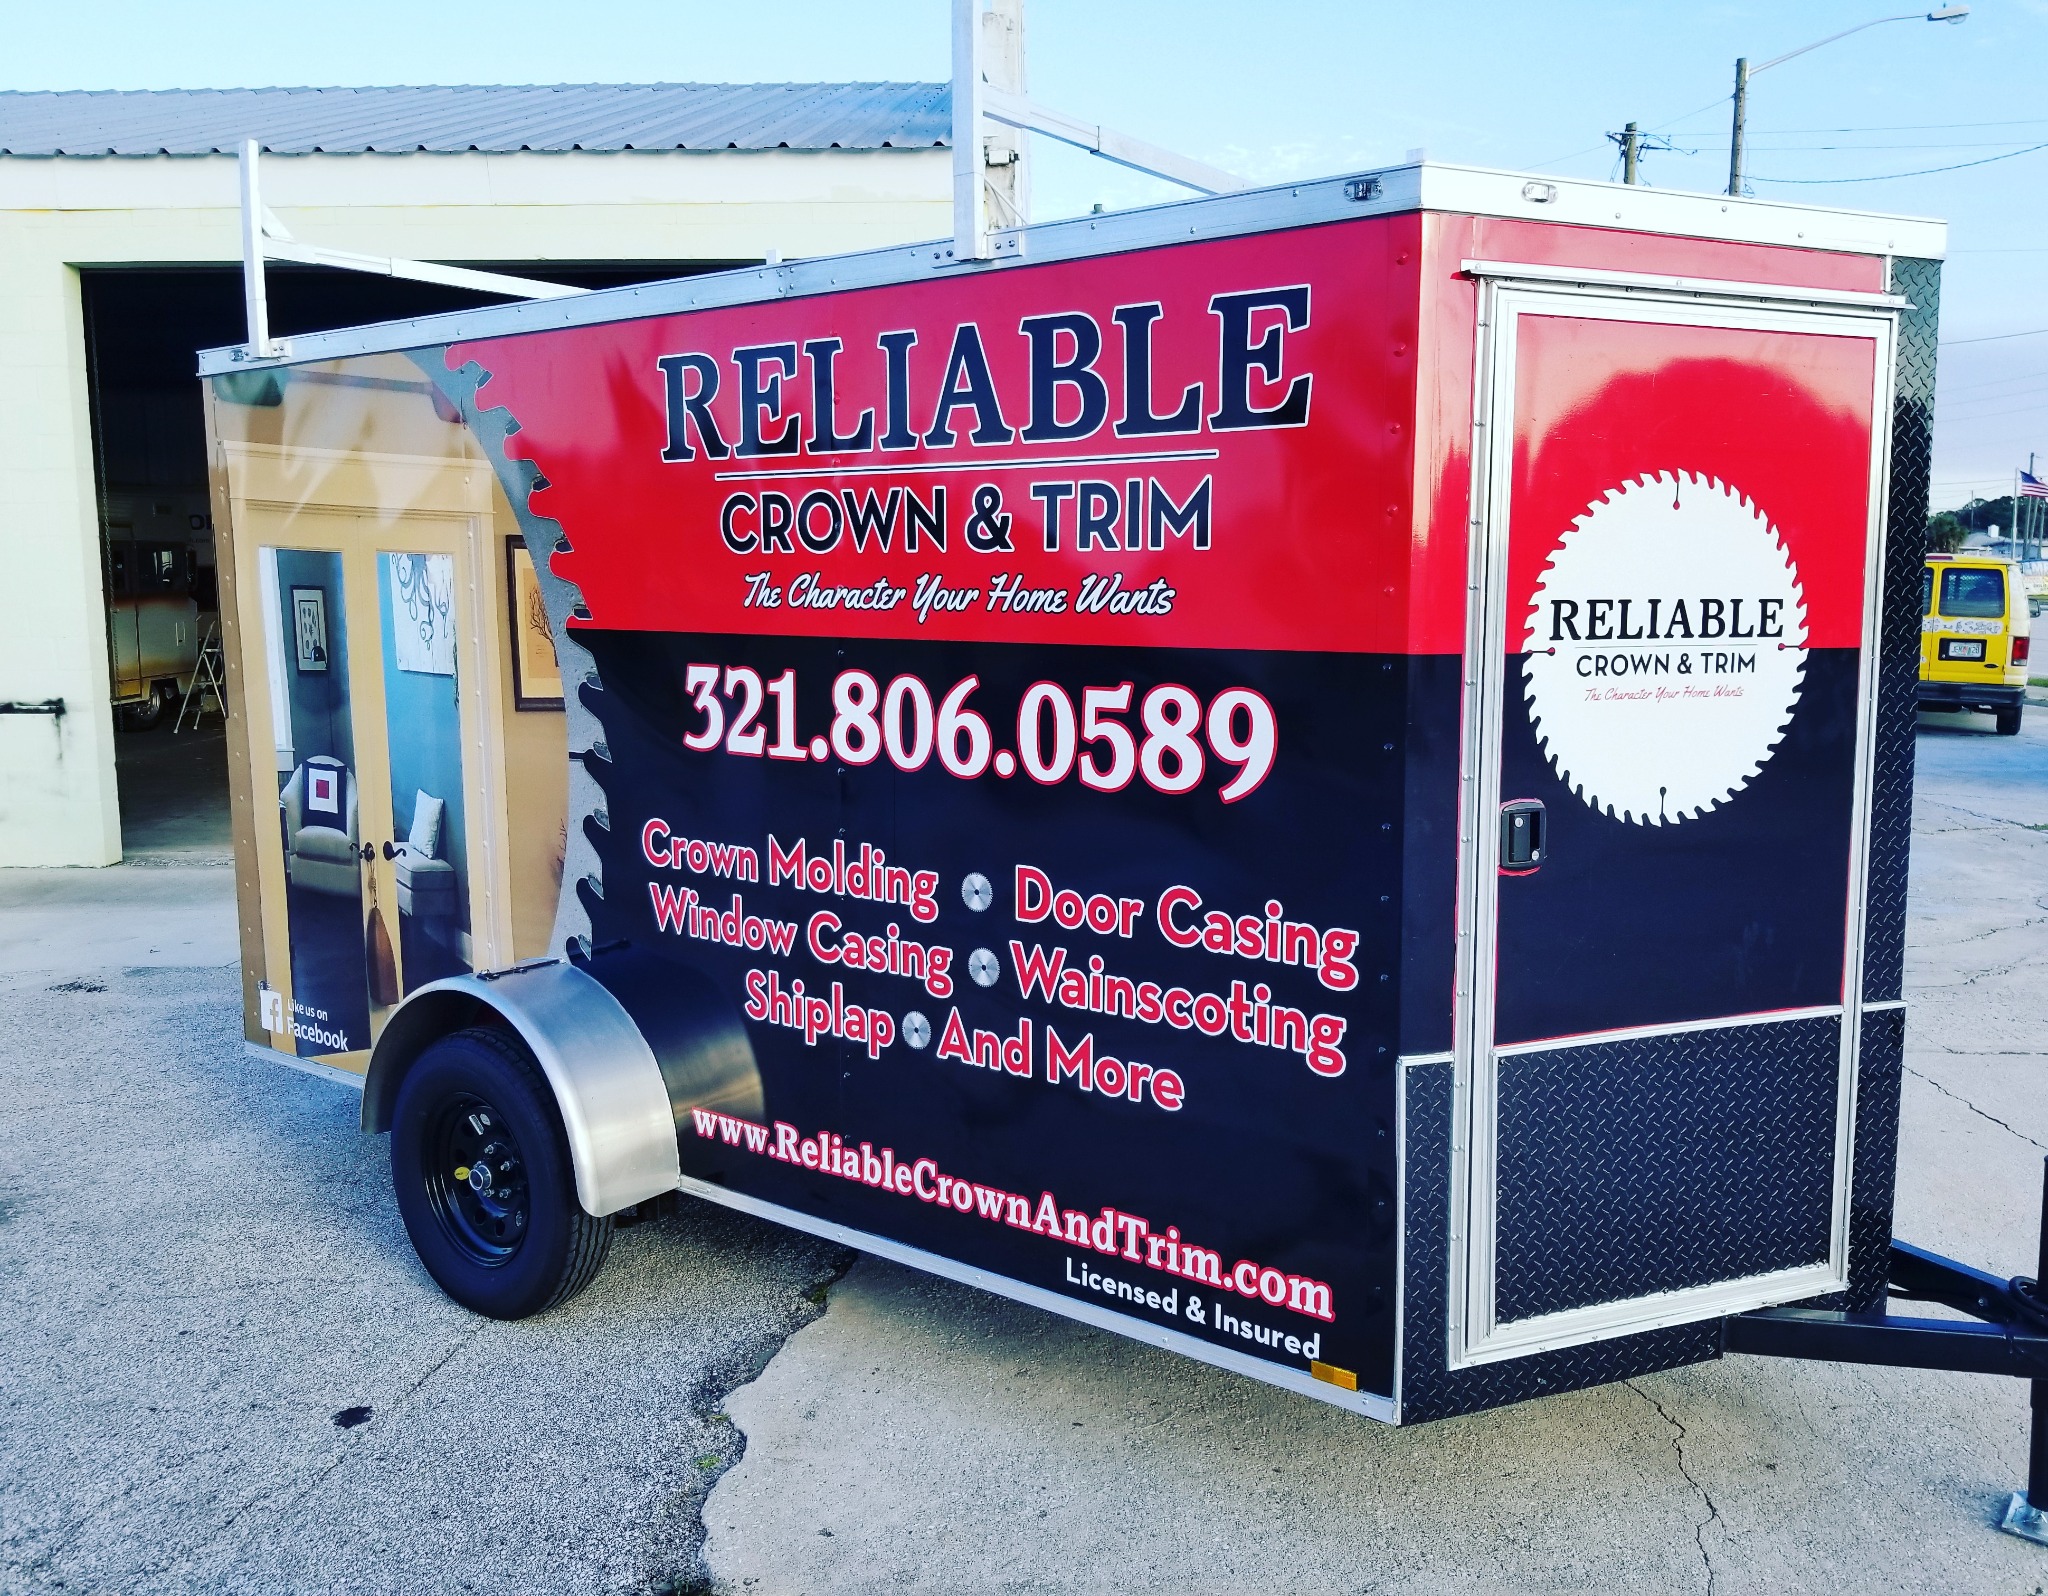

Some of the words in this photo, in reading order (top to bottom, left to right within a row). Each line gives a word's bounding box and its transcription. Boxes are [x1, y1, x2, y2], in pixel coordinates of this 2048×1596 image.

[656, 283, 1313, 464] RELIABLE
[720, 484, 947, 555] CROWN
[964, 482, 1015, 553] &
[1031, 474, 1213, 552] TRIM
[743, 572, 783, 609] The
[787, 571, 907, 611] Character
[914, 573, 980, 624] Your
[989, 574, 1068, 614] Home
[1076, 573, 1175, 616] Wants
[1549, 598, 1784, 641] RELIABLE
[1576, 653, 1670, 677] CROWN
[1677, 653, 1692, 674] &
[1701, 652, 1756, 674] TRIM
[1585, 688, 1601, 701] The
[1604, 687, 1652, 700] Character
[1655, 686, 1680, 703] Your
[1682, 685, 1710, 698] Home
[1713, 684, 1744, 698] Wants
[683, 661, 1279, 804] 321.806.0589
[641, 817, 759, 883] Crown
[767, 834, 940, 923] Molding
[648, 883, 799, 957] Window
[807, 910, 954, 998] Casing
[1015, 864, 1143, 939] Door
[1156, 885, 1360, 992] Casing
[286, 1015, 349, 1052] Facebook
[287, 998, 304, 1016] Like
[305, 1006, 315, 1017] us
[316, 1009, 328, 1022] on
[745, 970, 895, 1059] Shiplap
[936, 1005, 1034, 1079] And
[1046, 1025, 1185, 1112] More
[1008, 940, 1348, 1077] Wainscoting
[692, 1105, 1336, 1322] www.ReliableCrownAndTrim.com
[1065, 1257, 1179, 1315] Licensed
[1185, 1296, 1207, 1325] &
[1214, 1303, 1322, 1361] Insured
